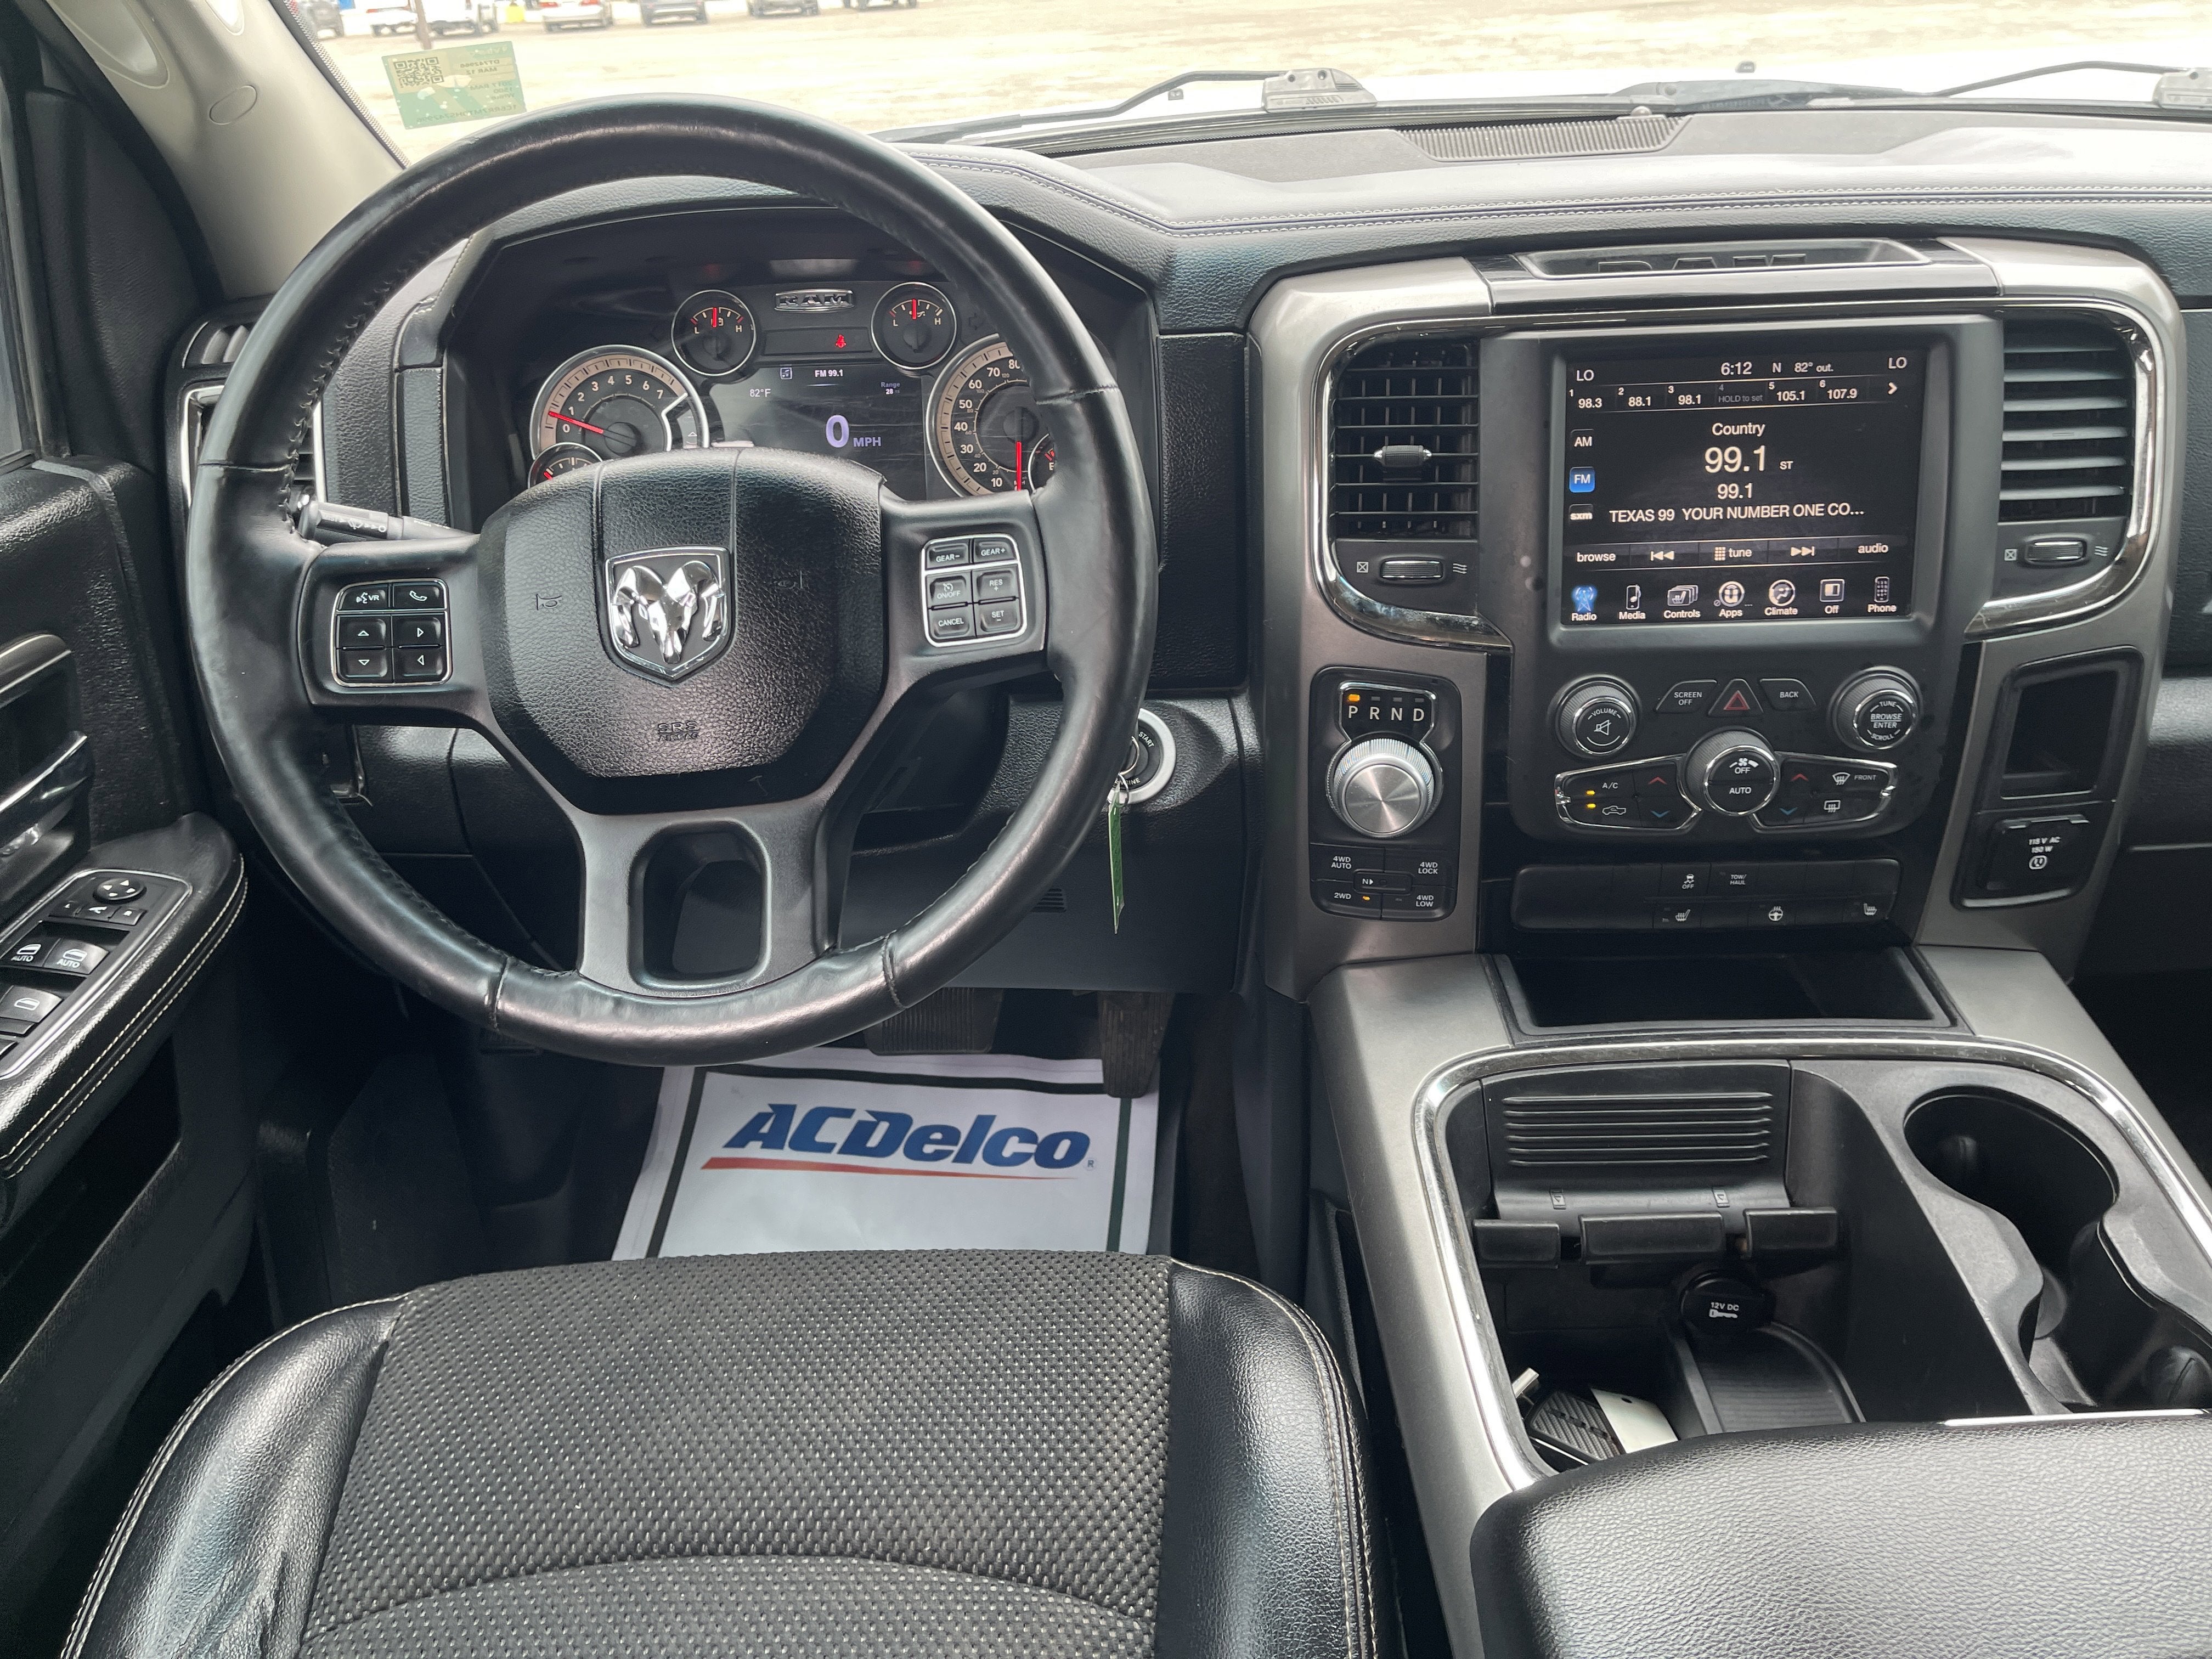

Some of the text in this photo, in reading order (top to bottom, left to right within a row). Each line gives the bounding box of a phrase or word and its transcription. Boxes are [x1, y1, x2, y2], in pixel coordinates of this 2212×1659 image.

[780, 295, 845, 307] RAM
[1888, 357, 1908, 369] LO
[987, 367, 1000, 377] 70
[1720, 362, 1752, 375] 6:12
[1772, 362, 1781, 373] N
[1816, 362, 1834, 373] out.
[607, 375, 615, 385] 4
[625, 375, 632, 385] 5
[1576, 370, 1594, 381] LO
[591, 381, 599, 391] 3
[642, 381, 650, 390] 6
[968, 379, 982, 389] 60
[657, 390, 664, 399] 7
[749, 388, 771, 398] 82°F
[1768, 381, 1805, 402] 5 105.1
[1819, 380, 1858, 400] 6 107.9
[578, 393, 585, 402] 2
[1618, 387, 1651, 407] 2 88.1
[1678, 394, 1701, 405] 98.1
[959, 399, 973, 409] 50
[1578, 398, 1602, 409] 98.3
[569, 407, 574, 415] 1
[562, 424, 570, 433] 0
[826, 415, 882, 448] 0 MPH
[954, 422, 968, 431] 40
[1712, 422, 1765, 437] Country
[1574, 437, 1593, 447] AM
[961, 444, 974, 453] 30
[1705, 445, 1793, 473] 99.1 ST
[974, 462, 987, 472] 20
[991, 477, 1003, 487] 10
[1574, 474, 1590, 484] FM
[1717, 483, 1753, 500] 99.1
[1609, 509, 1655, 522] TEXAS
[1658, 509, 1675, 521] 99
[1681, 507, 1723, 521] YOUR
[1726, 505, 1790, 520] NUMBER
[1792, 504, 1824, 517] ONE
[1729, 548, 1752, 558] tune
[1858, 543, 1889, 554] audio
[1577, 552, 1616, 562] browse
[937, 590, 961, 599] ON/OFF
[1719, 608, 1743, 618] Apps
[1764, 607, 1798, 616] Climate
[1825, 605, 1839, 614] Off
[1867, 604, 1897, 613] Phone
[992, 610, 1005, 618] SET
[1571, 613, 1597, 621] Radio
[1619, 611, 1646, 620] Media
[1663, 610, 1701, 619] Controls
[938, 618, 964, 627] CANCEL
[1348, 706, 1358, 719] P
[1369, 706, 1380, 720] R
[1391, 707, 1403, 721] N
[1413, 708, 1425, 721] D
[1592, 708, 1618, 716] VOLUME
[658, 721, 699, 733] SRS
[1138, 731, 1154, 747] START
[1871, 732, 1894, 741] SCROLL
[1729, 787, 1751, 795] AUTO
[57, 960, 81, 968] AUTO
[723, 1103, 1090, 1169] ACDelco
